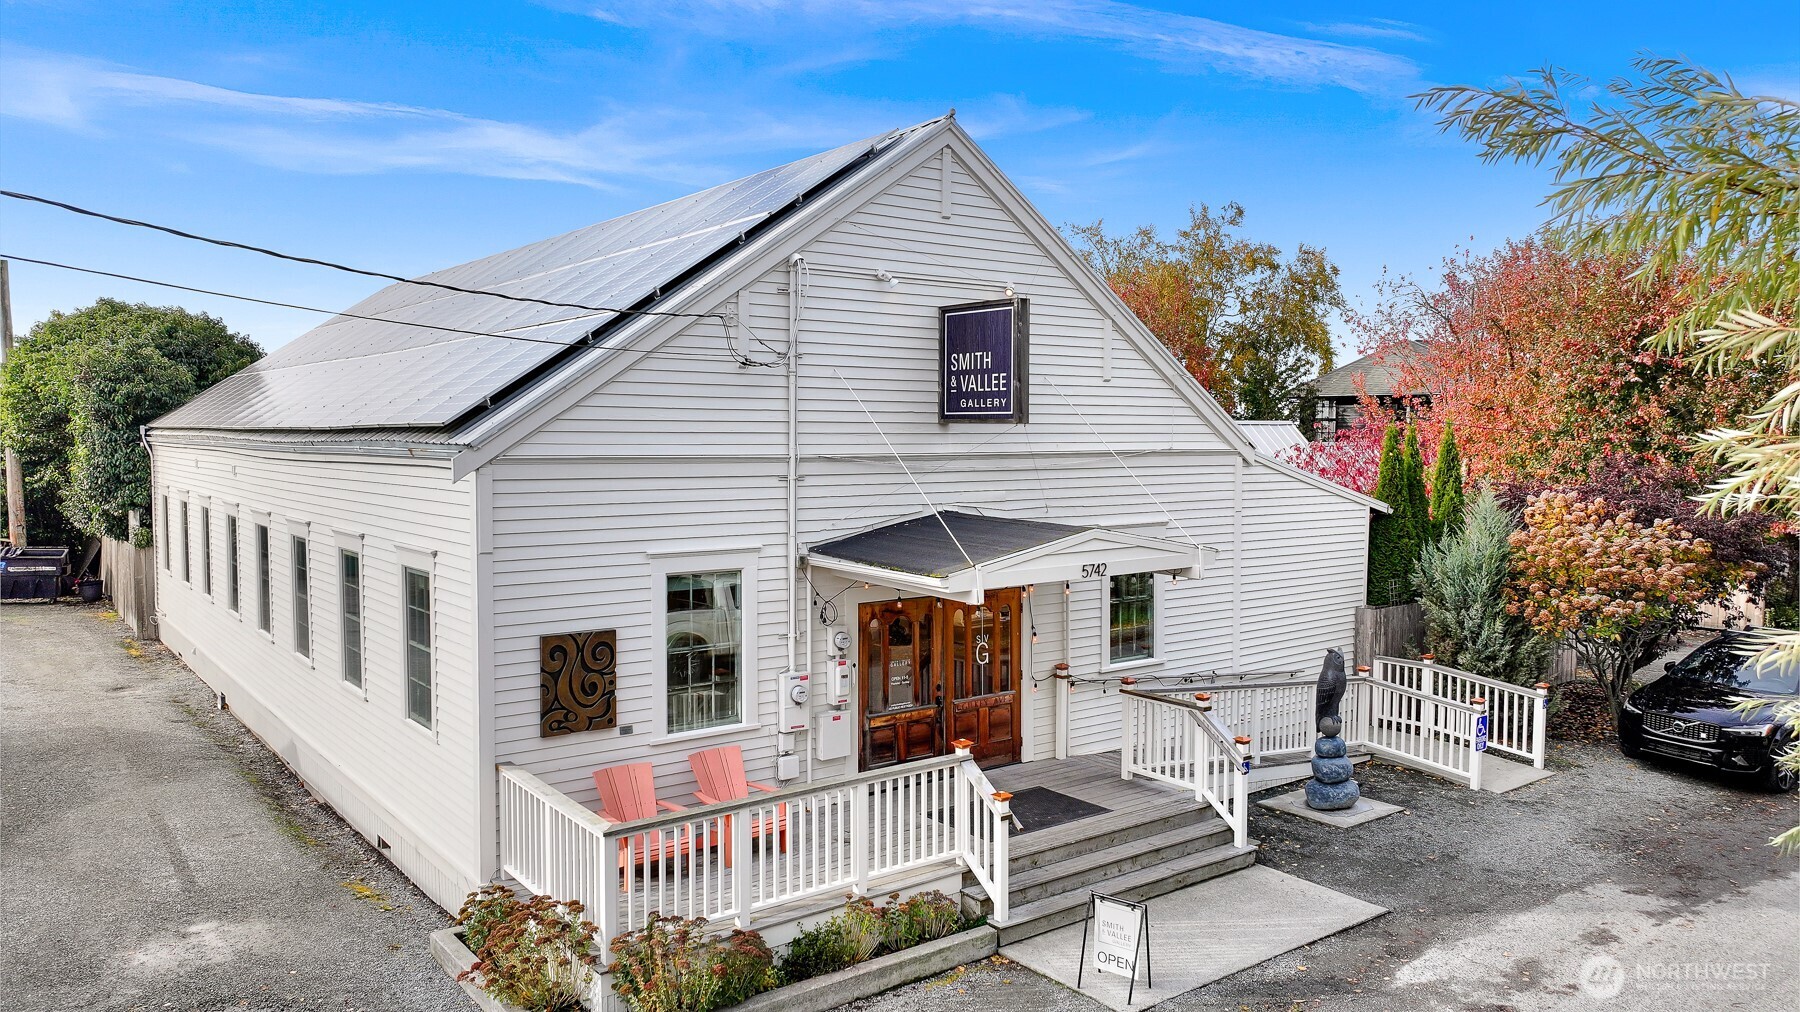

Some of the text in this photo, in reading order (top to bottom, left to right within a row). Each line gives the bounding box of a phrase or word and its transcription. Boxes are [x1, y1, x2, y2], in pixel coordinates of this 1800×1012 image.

[951, 351, 991, 371] SMITH
[950, 373, 1007, 392] & VALLEE
[960, 398, 1007, 408] GALLERY
[1082, 562, 1107, 578] 5742
[976, 642, 989, 664] G
[1101, 920, 1124, 932] SMITH
[1106, 929, 1132, 943] VALLEE
[1097, 951, 1135, 972] OPEN
